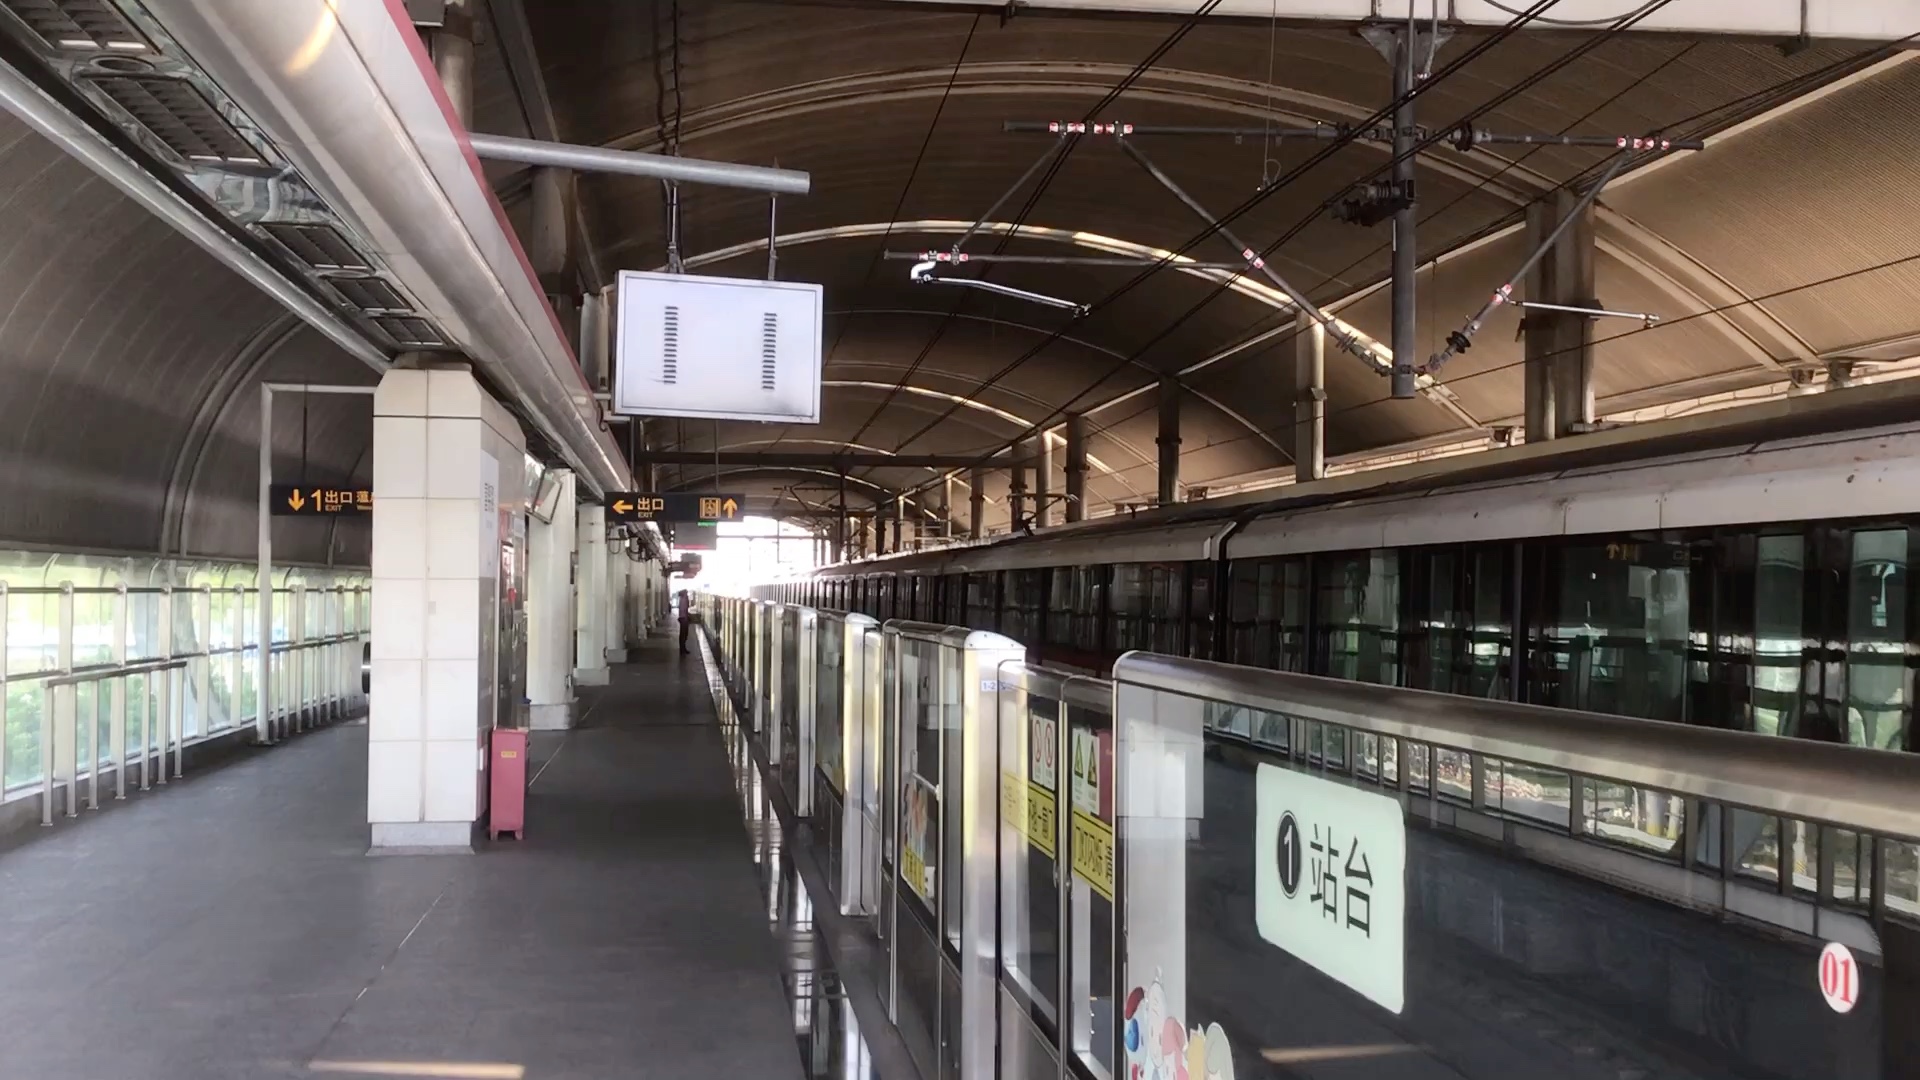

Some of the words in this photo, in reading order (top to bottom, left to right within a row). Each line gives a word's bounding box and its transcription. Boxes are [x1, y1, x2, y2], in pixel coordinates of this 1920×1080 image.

[311, 489, 321, 512] 1
[325, 490, 352, 504] 出口
[637, 497, 664, 511] 出口
[1310, 823, 1374, 940] 站台
[1822, 951, 1853, 1005] 01
